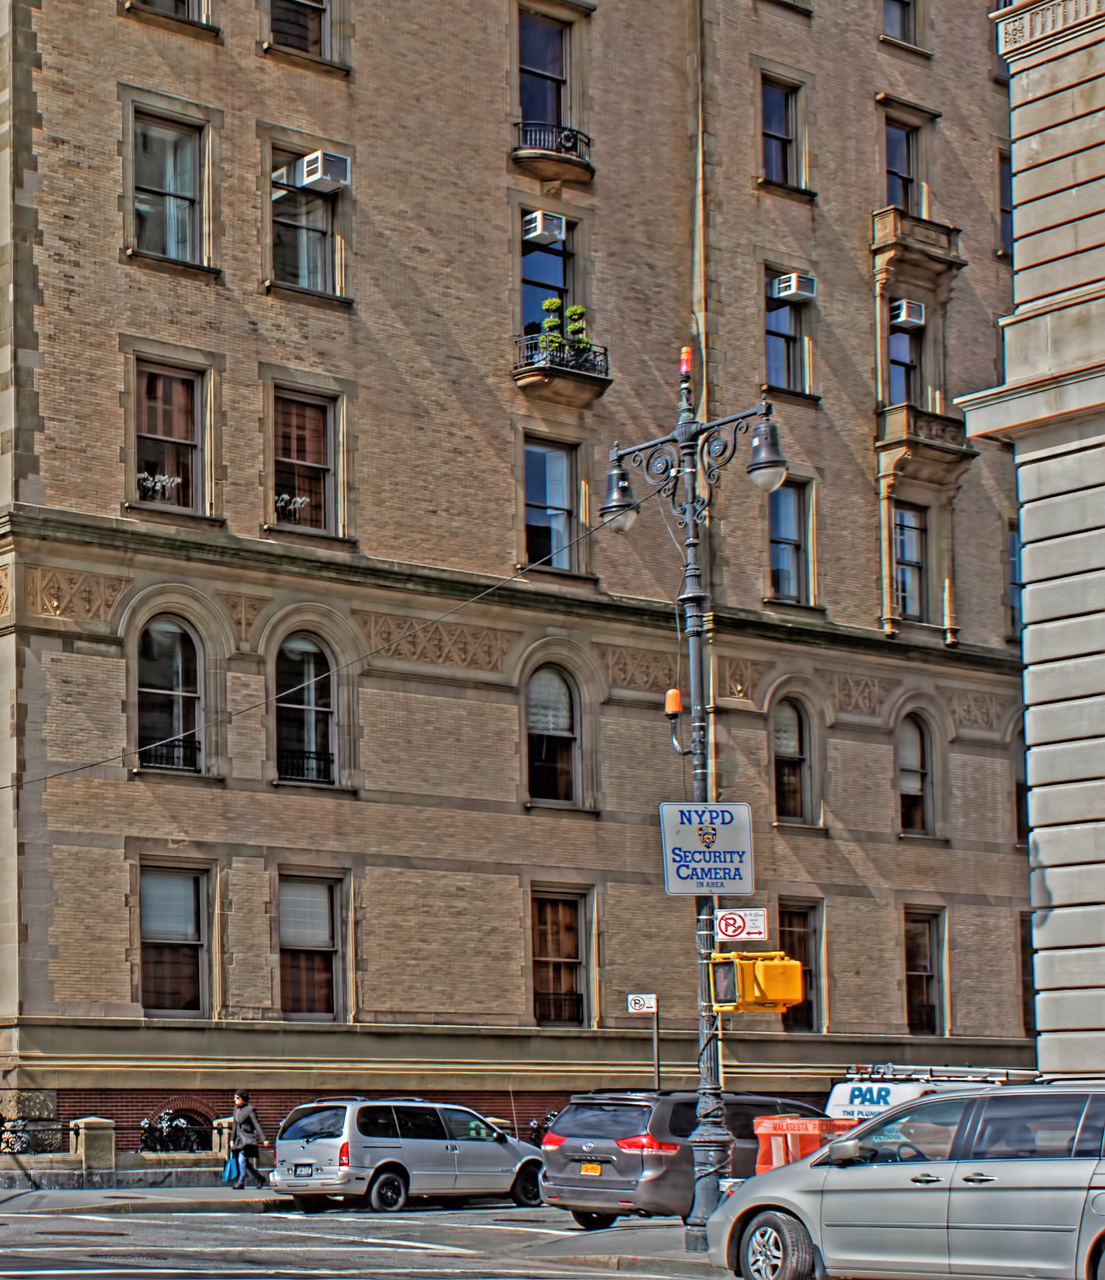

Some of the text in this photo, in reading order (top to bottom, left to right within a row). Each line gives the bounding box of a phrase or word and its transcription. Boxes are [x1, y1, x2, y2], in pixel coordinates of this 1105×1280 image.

[678, 809, 734, 825] NYPD
[671, 847, 746, 863] SECURITY
[676, 864, 743, 880] CAMERA
[849, 1086, 890, 1105] PAR
